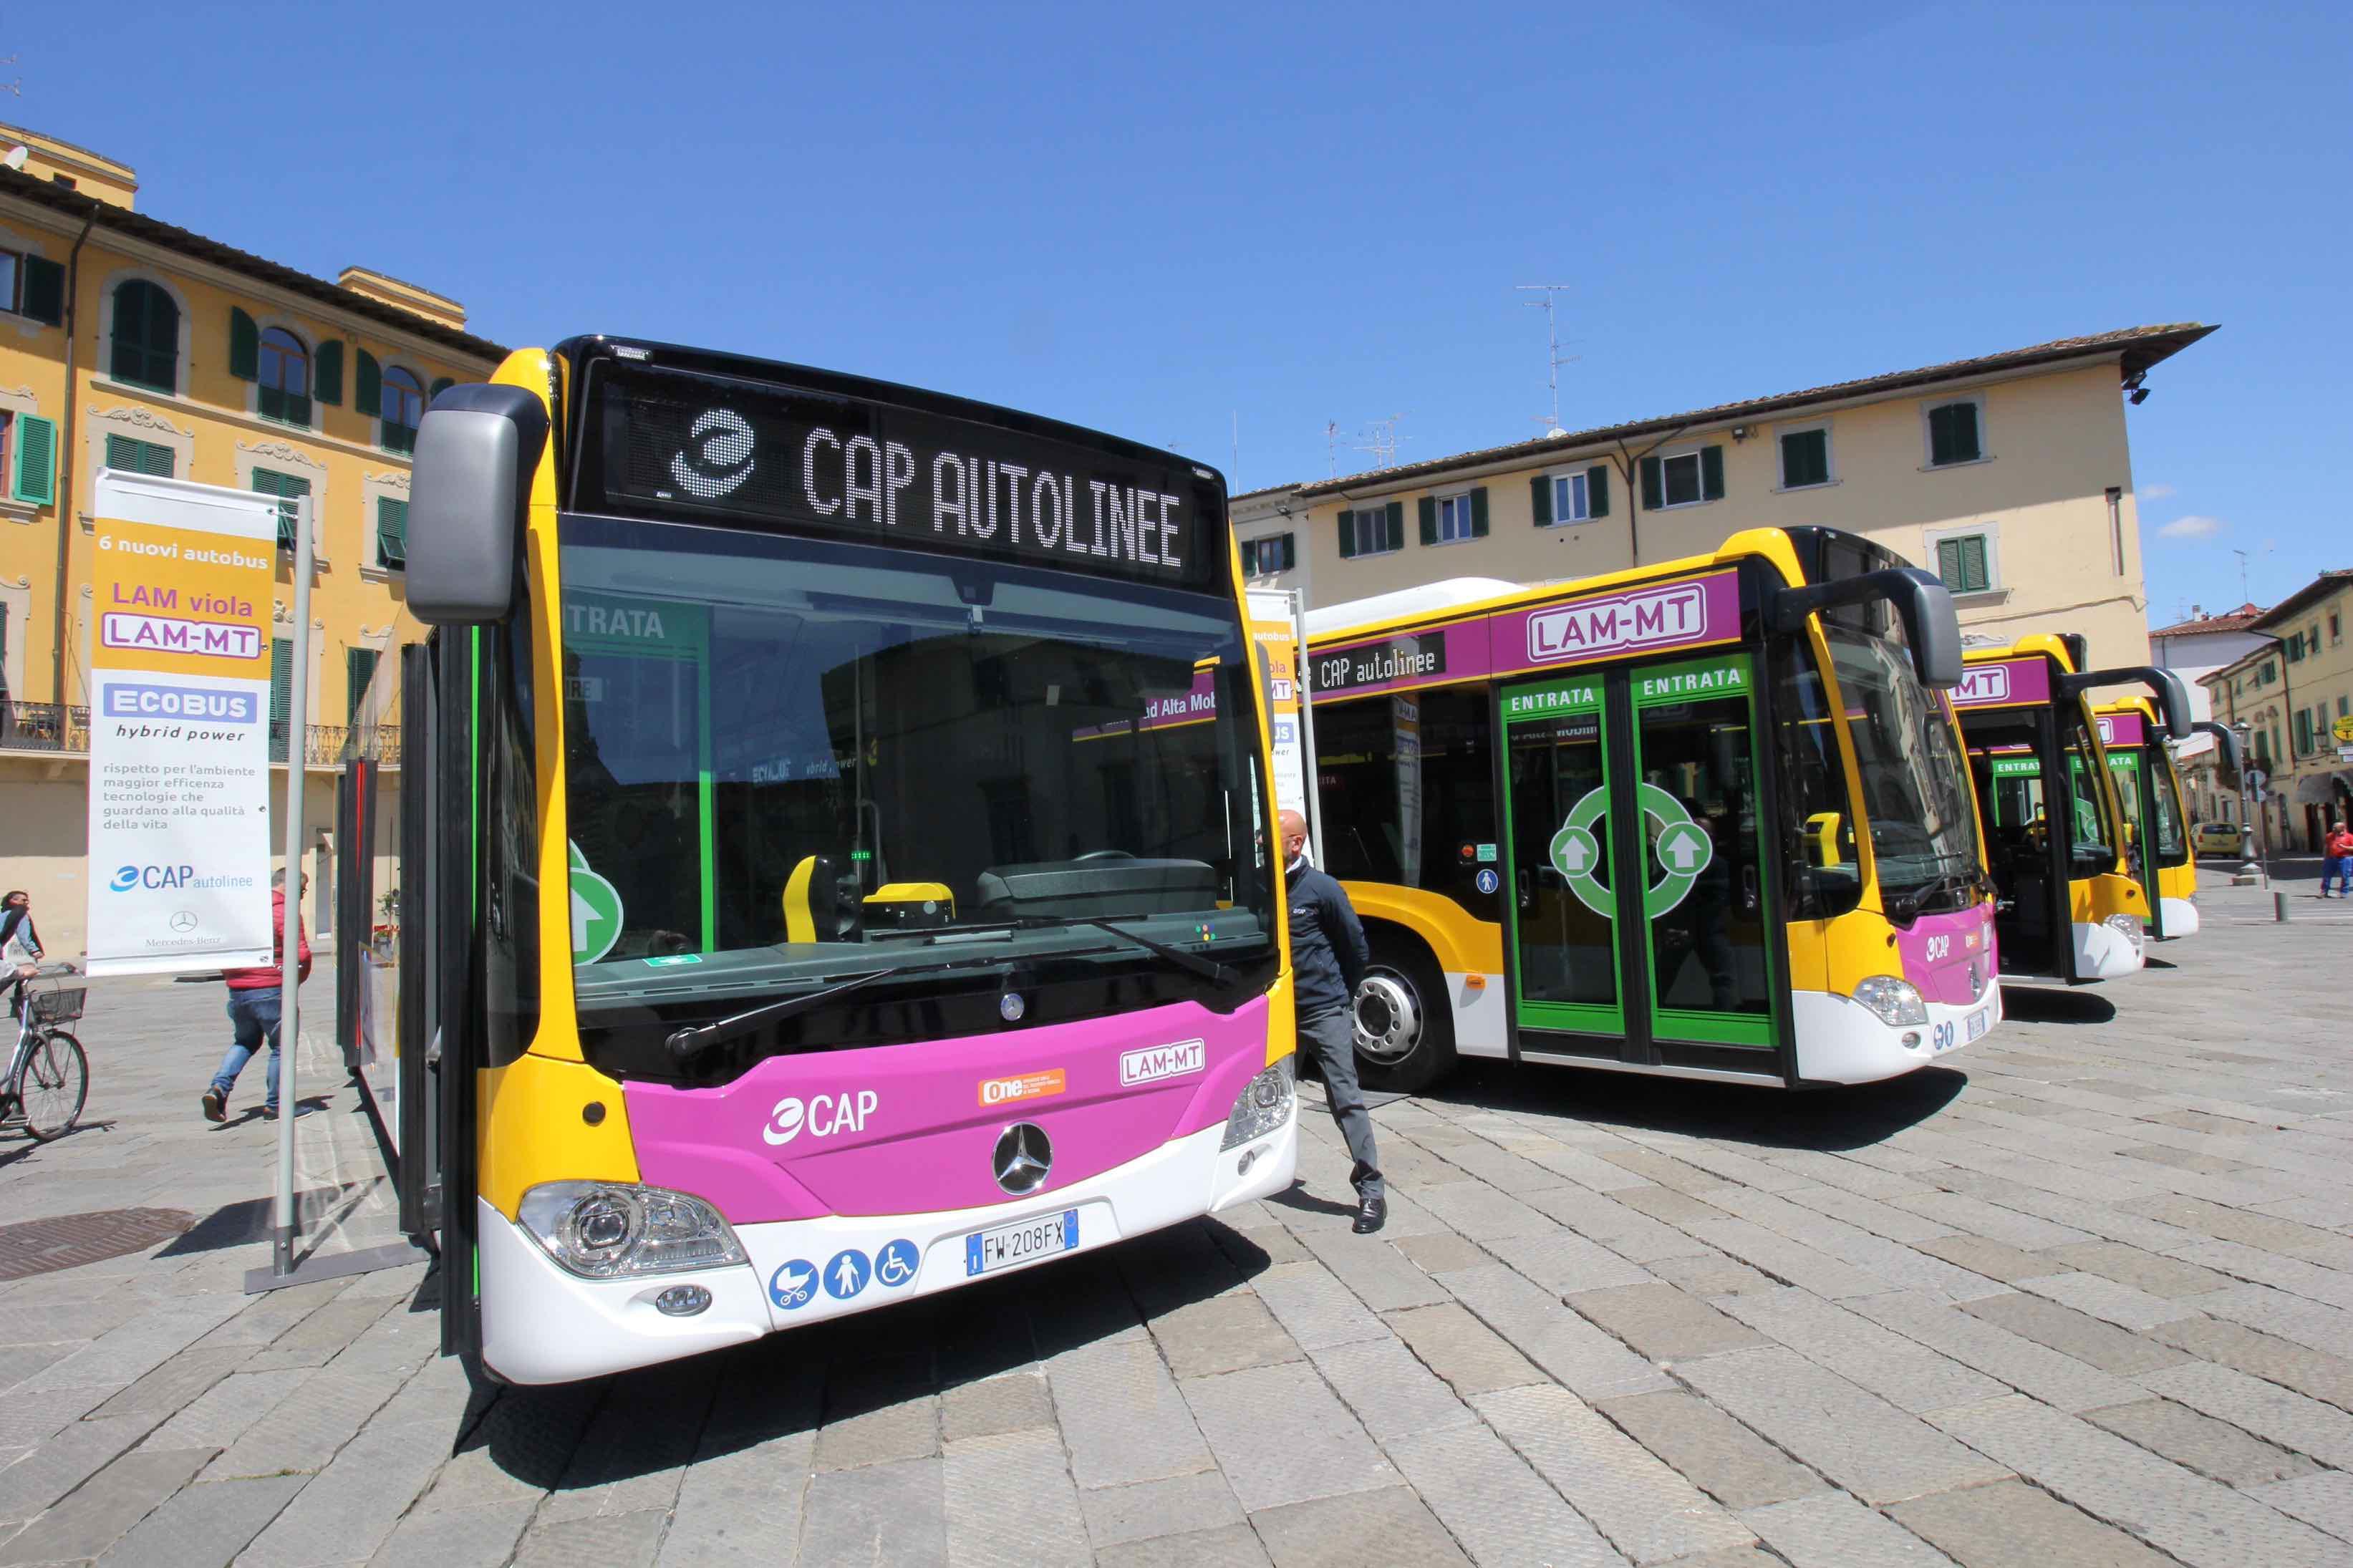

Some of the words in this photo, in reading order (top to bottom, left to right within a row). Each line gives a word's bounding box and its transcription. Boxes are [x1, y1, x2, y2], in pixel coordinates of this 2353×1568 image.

[803, 425, 916, 526] CAP
[932, 450, 1182, 568] AUTOLINEE
[99, 535, 112, 551] 6
[118, 539, 178, 558] nuovi
[183, 548, 269, 568] autobus
[112, 582, 178, 609] LAM
[189, 593, 253, 617] viola
[563, 604, 665, 639] TRATA
[1536, 595, 1695, 653] LAM-MT
[111, 618, 256, 654] LAM-MT
[1320, 657, 1350, 688] CAP
[1356, 647, 1435, 682] autolinee
[1644, 667, 1741, 697] ENTRATA
[113, 689, 247, 718] ECOBUS
[1161, 697, 1187, 717] Alta
[1511, 687, 1595, 712] ENTRATA
[116, 724, 180, 740] hybrid
[186, 730, 246, 742] power
[103, 763, 159, 775] rispetto
[163, 765, 186, 775] per
[190, 765, 256, 777] l'ambiente
[103, 778, 159, 790] maggior
[164, 778, 225, 789] efficenza
[103, 791, 178, 804] tecnologie
[181, 792, 204, 803] che
[103, 805, 168, 818] guardano
[173, 805, 197, 816] alla
[200, 805, 246, 818] qualità
[103, 819, 138, 830] della
[142, 820, 168, 830] vita
[142, 865, 194, 889] CAP
[193, 874, 253, 889] autolinee
[145, 935, 221, 948] Mercedes-Benz
[1935, 934, 1949, 959] CAP
[1126, 1045, 1200, 1080] LAM-MT
[983, 1079, 1023, 1103] One
[808, 1090, 878, 1138] CAP
